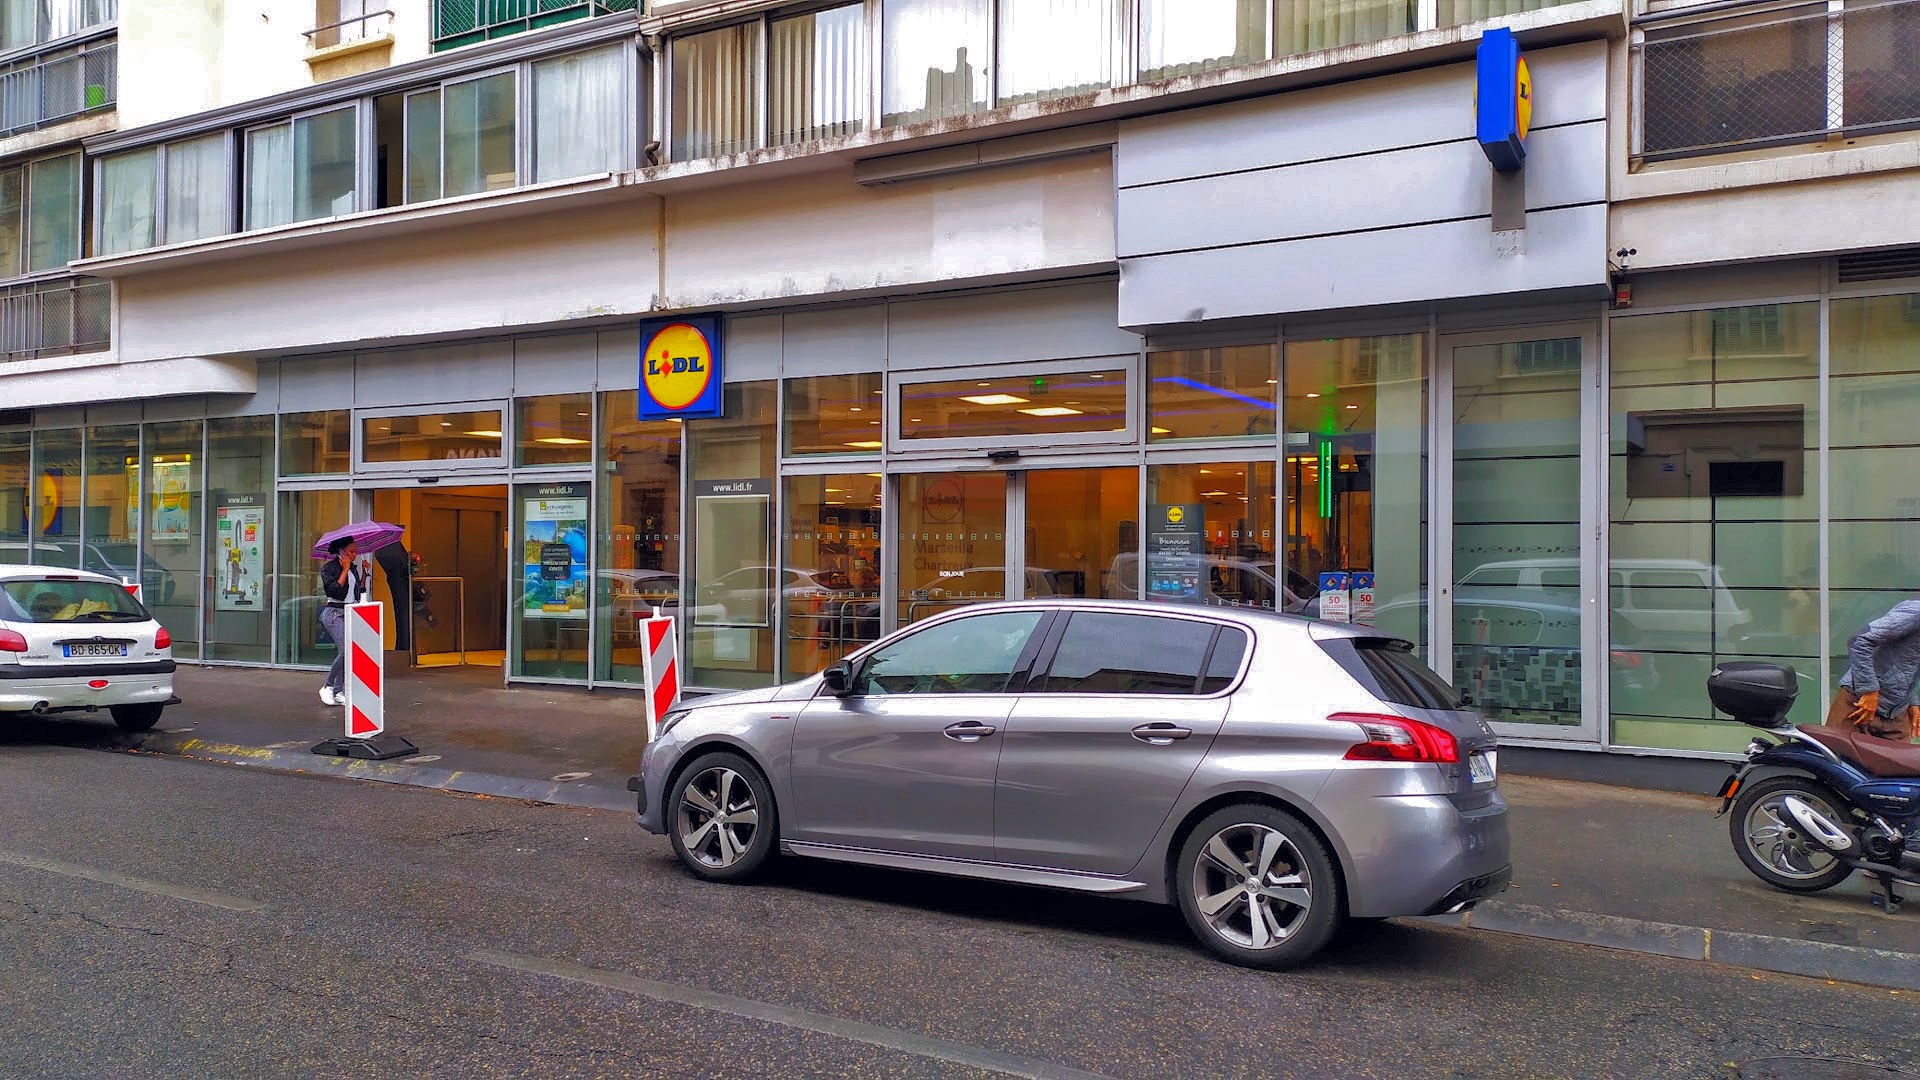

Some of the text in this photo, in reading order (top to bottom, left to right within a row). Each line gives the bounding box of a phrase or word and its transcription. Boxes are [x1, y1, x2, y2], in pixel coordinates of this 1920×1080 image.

[538, 485, 574, 495] www.lidl.fr
[712, 482, 753, 492] www.lidl.fr
[913, 541, 974, 554] Marseille
[913, 557, 974, 571] Chartreux
[1328, 596, 1341, 604] 50
[1360, 594, 1372, 602] 50
